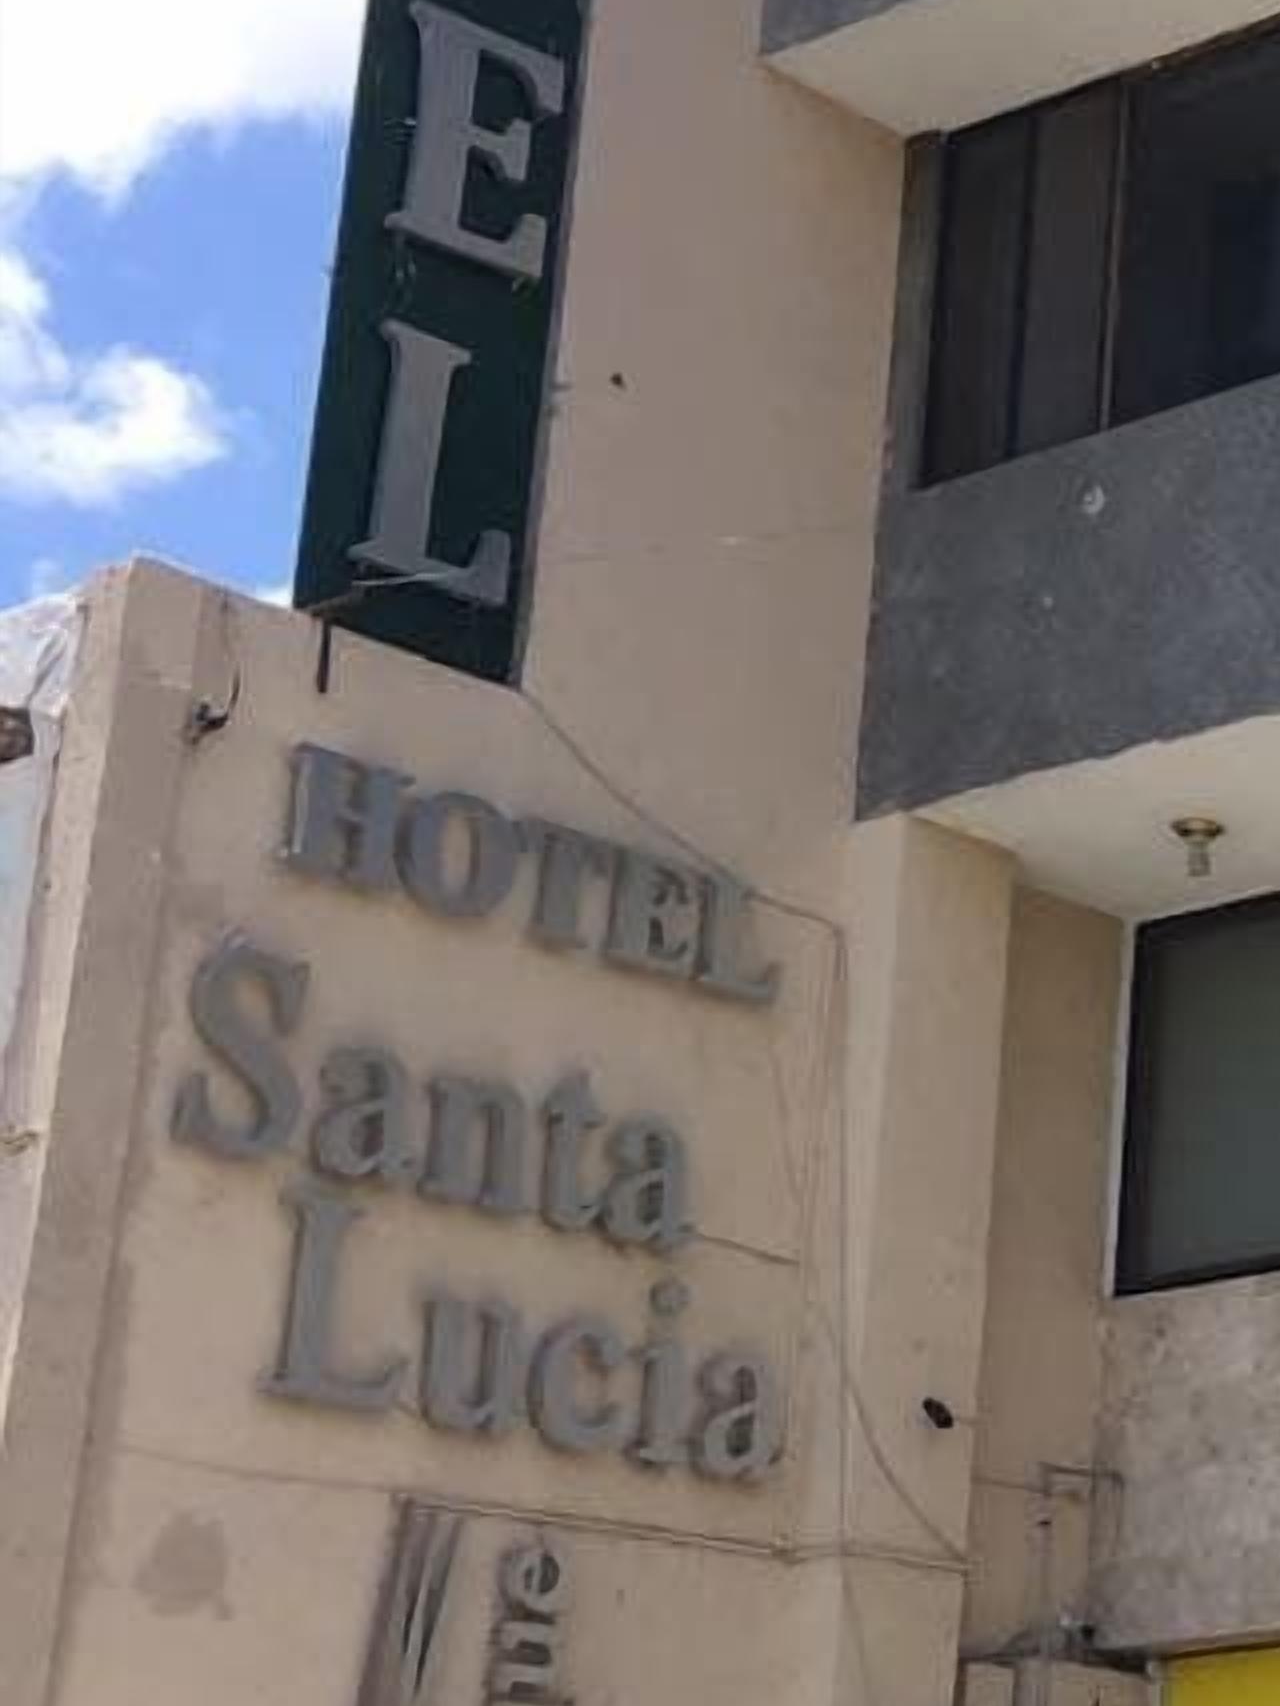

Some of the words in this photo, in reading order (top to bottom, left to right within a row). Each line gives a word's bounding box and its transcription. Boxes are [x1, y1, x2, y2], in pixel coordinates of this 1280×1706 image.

[276, 738, 780, 1008] HOTEL
[170, 930, 698, 1254] Santa
[262, 1181, 785, 1489] Lucia
